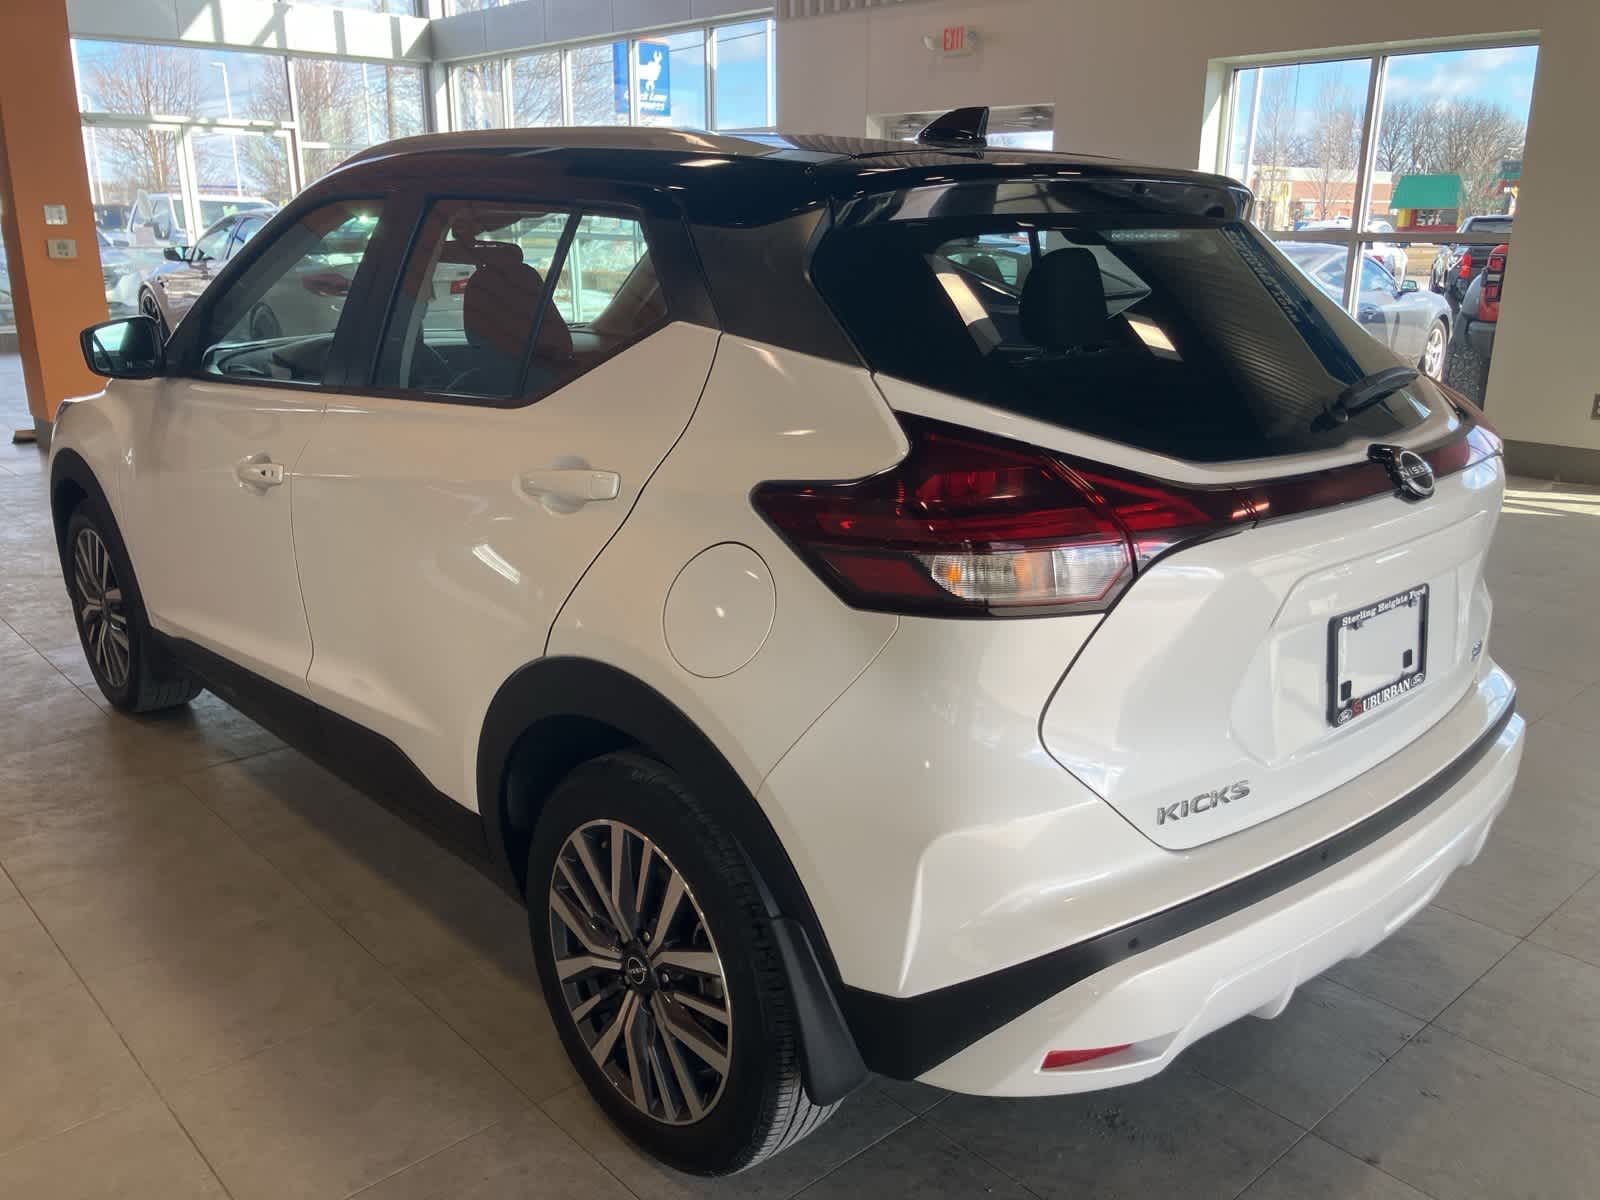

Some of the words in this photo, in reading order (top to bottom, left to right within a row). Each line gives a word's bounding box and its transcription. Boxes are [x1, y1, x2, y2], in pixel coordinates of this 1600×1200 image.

[944, 25, 965, 52] EXIT
[1342, 607, 1377, 626] Sterling
[1377, 595, 1408, 612] Heights
[1409, 585, 1426, 600] Ford
[1352, 678, 1410, 714] SUBURBAN
[1156, 779, 1251, 825] KICKS
